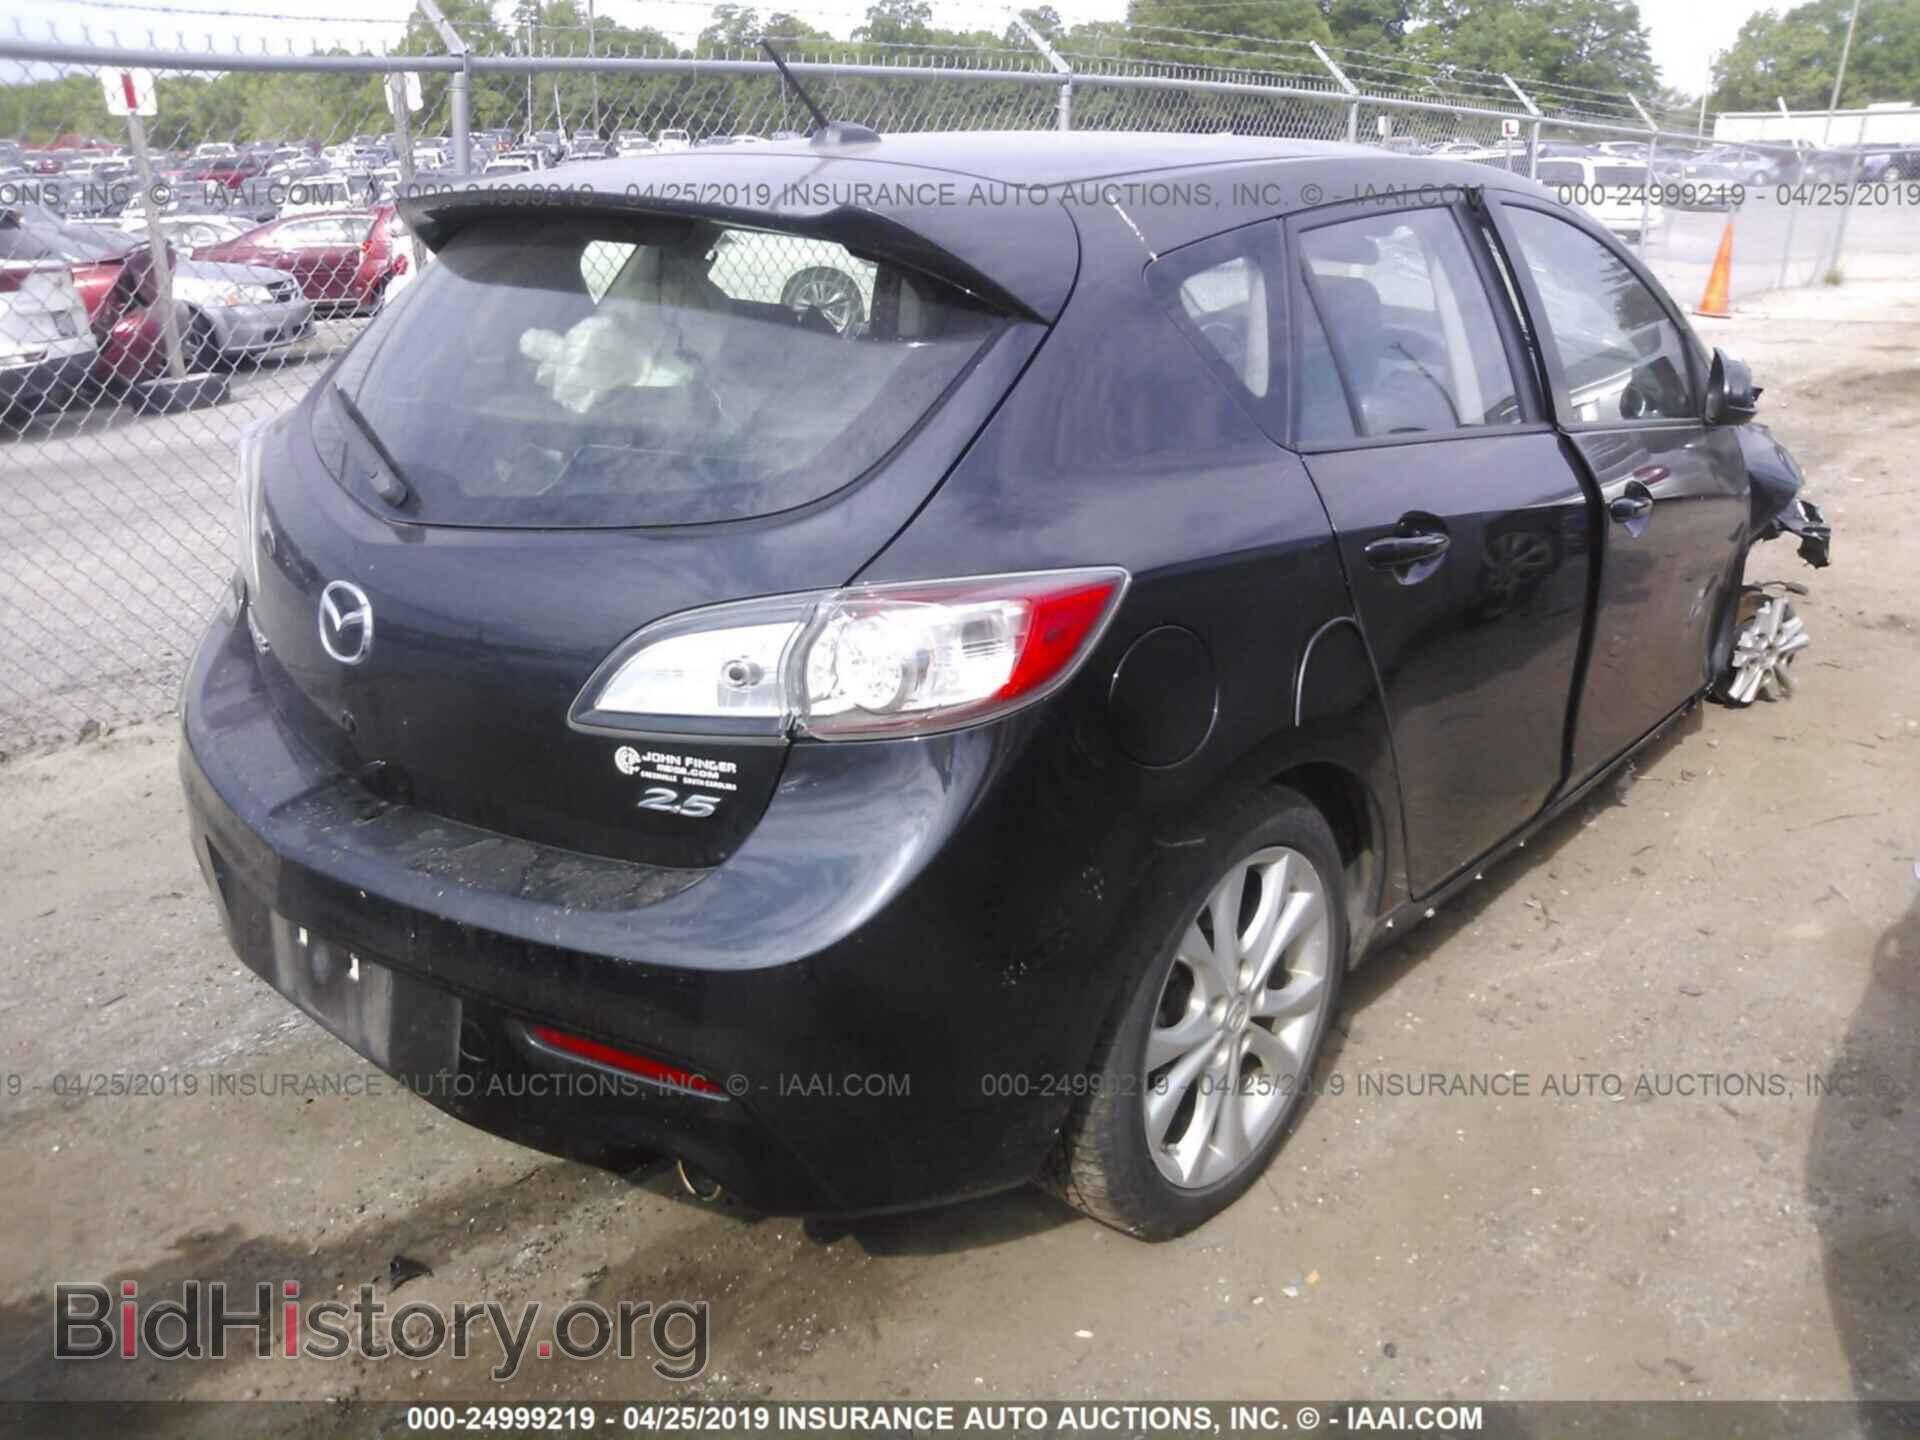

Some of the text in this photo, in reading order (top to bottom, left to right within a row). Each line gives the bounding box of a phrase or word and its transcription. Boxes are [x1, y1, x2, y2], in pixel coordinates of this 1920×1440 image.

[641, 751, 737, 774] JOHN FINGER
[637, 787, 721, 818] 2.5
